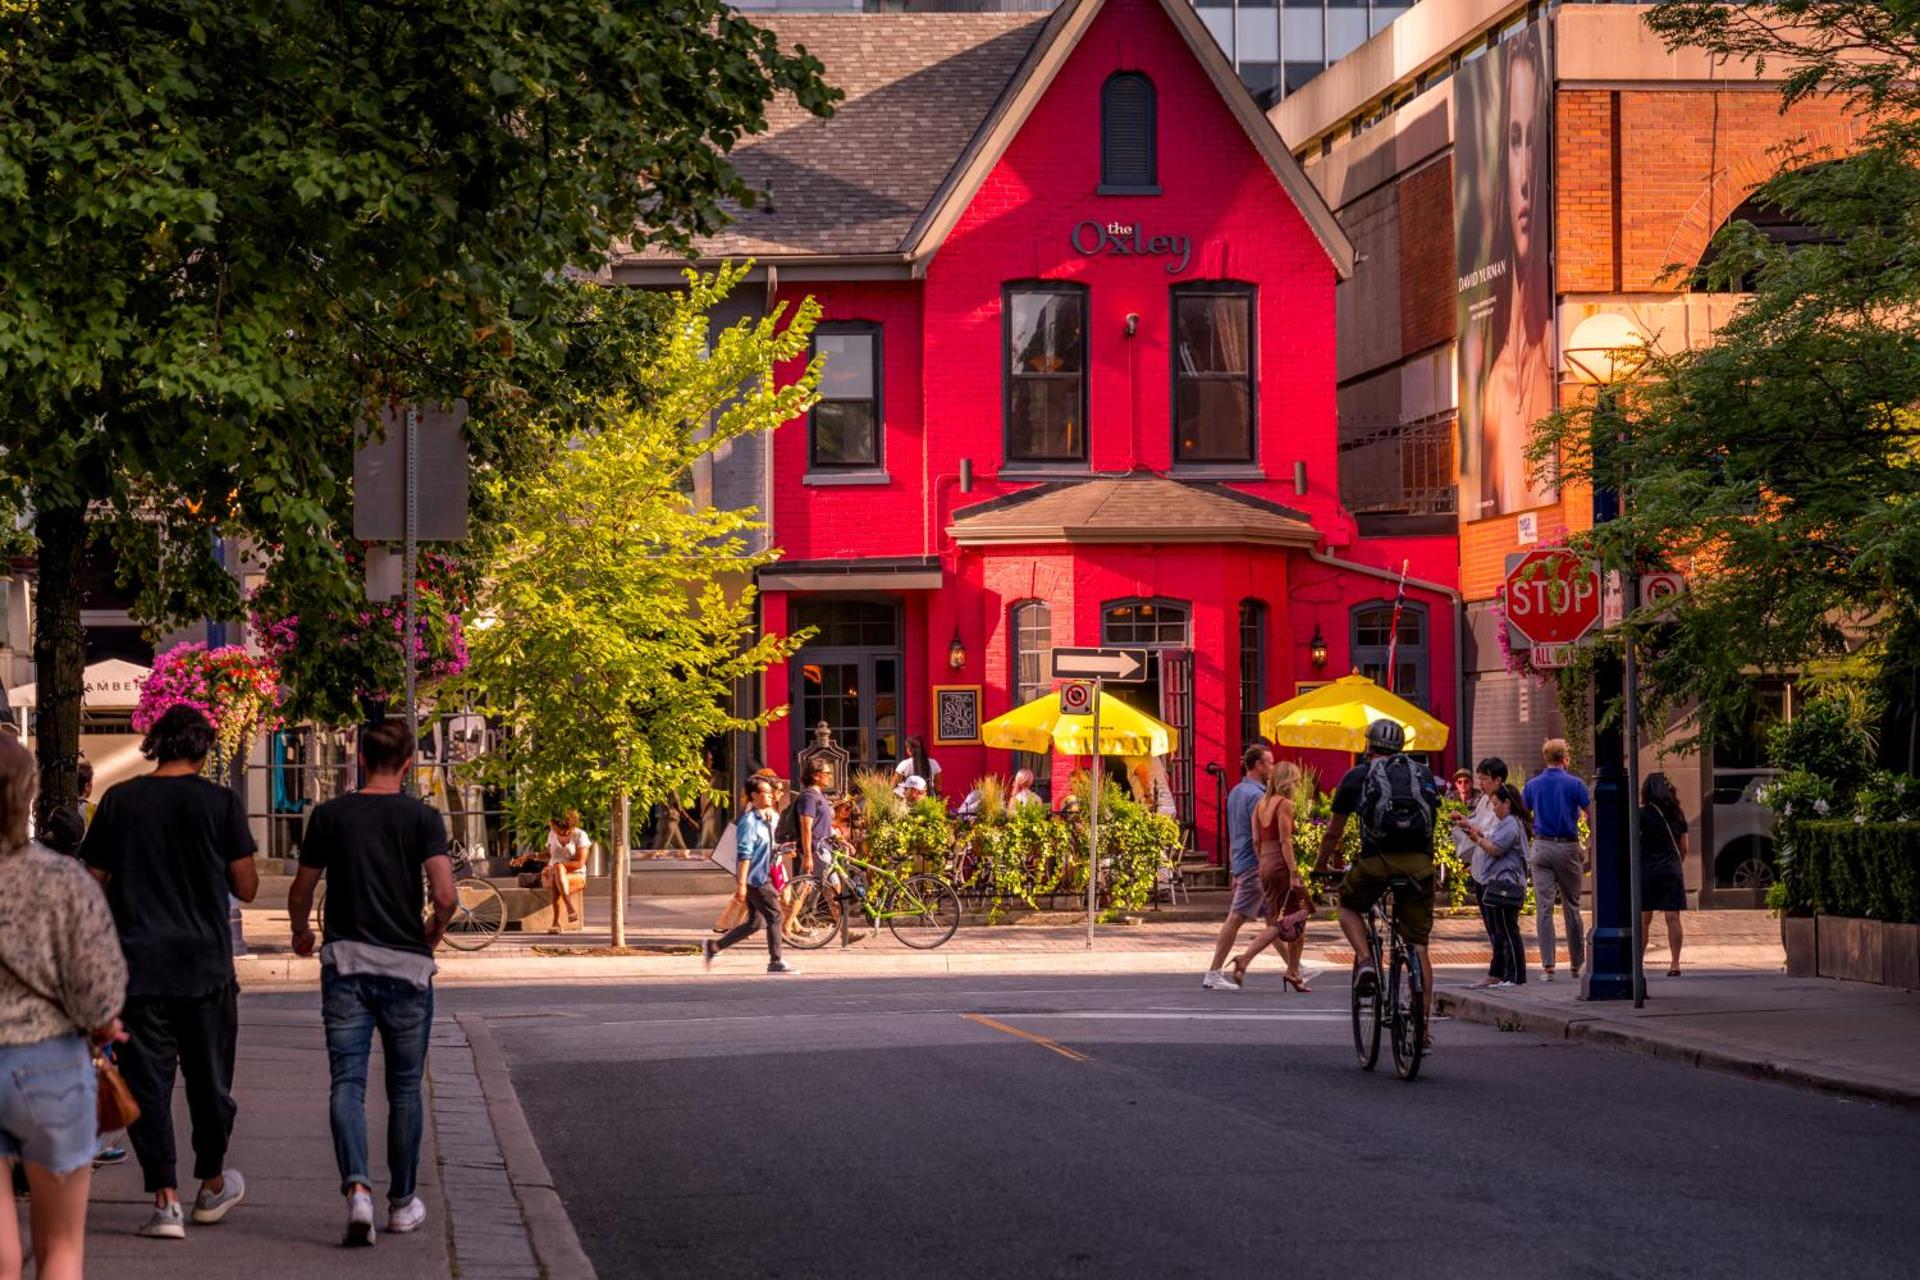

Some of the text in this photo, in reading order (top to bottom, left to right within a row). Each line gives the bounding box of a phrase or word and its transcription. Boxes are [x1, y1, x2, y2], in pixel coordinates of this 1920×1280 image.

[1107, 222, 1132, 235] the
[1071, 220, 1191, 274] Oxley
[1458, 259, 1506, 293] DAVID YURMAN
[1512, 579, 1593, 616] STOP
[1535, 647, 1552, 665] ALL
